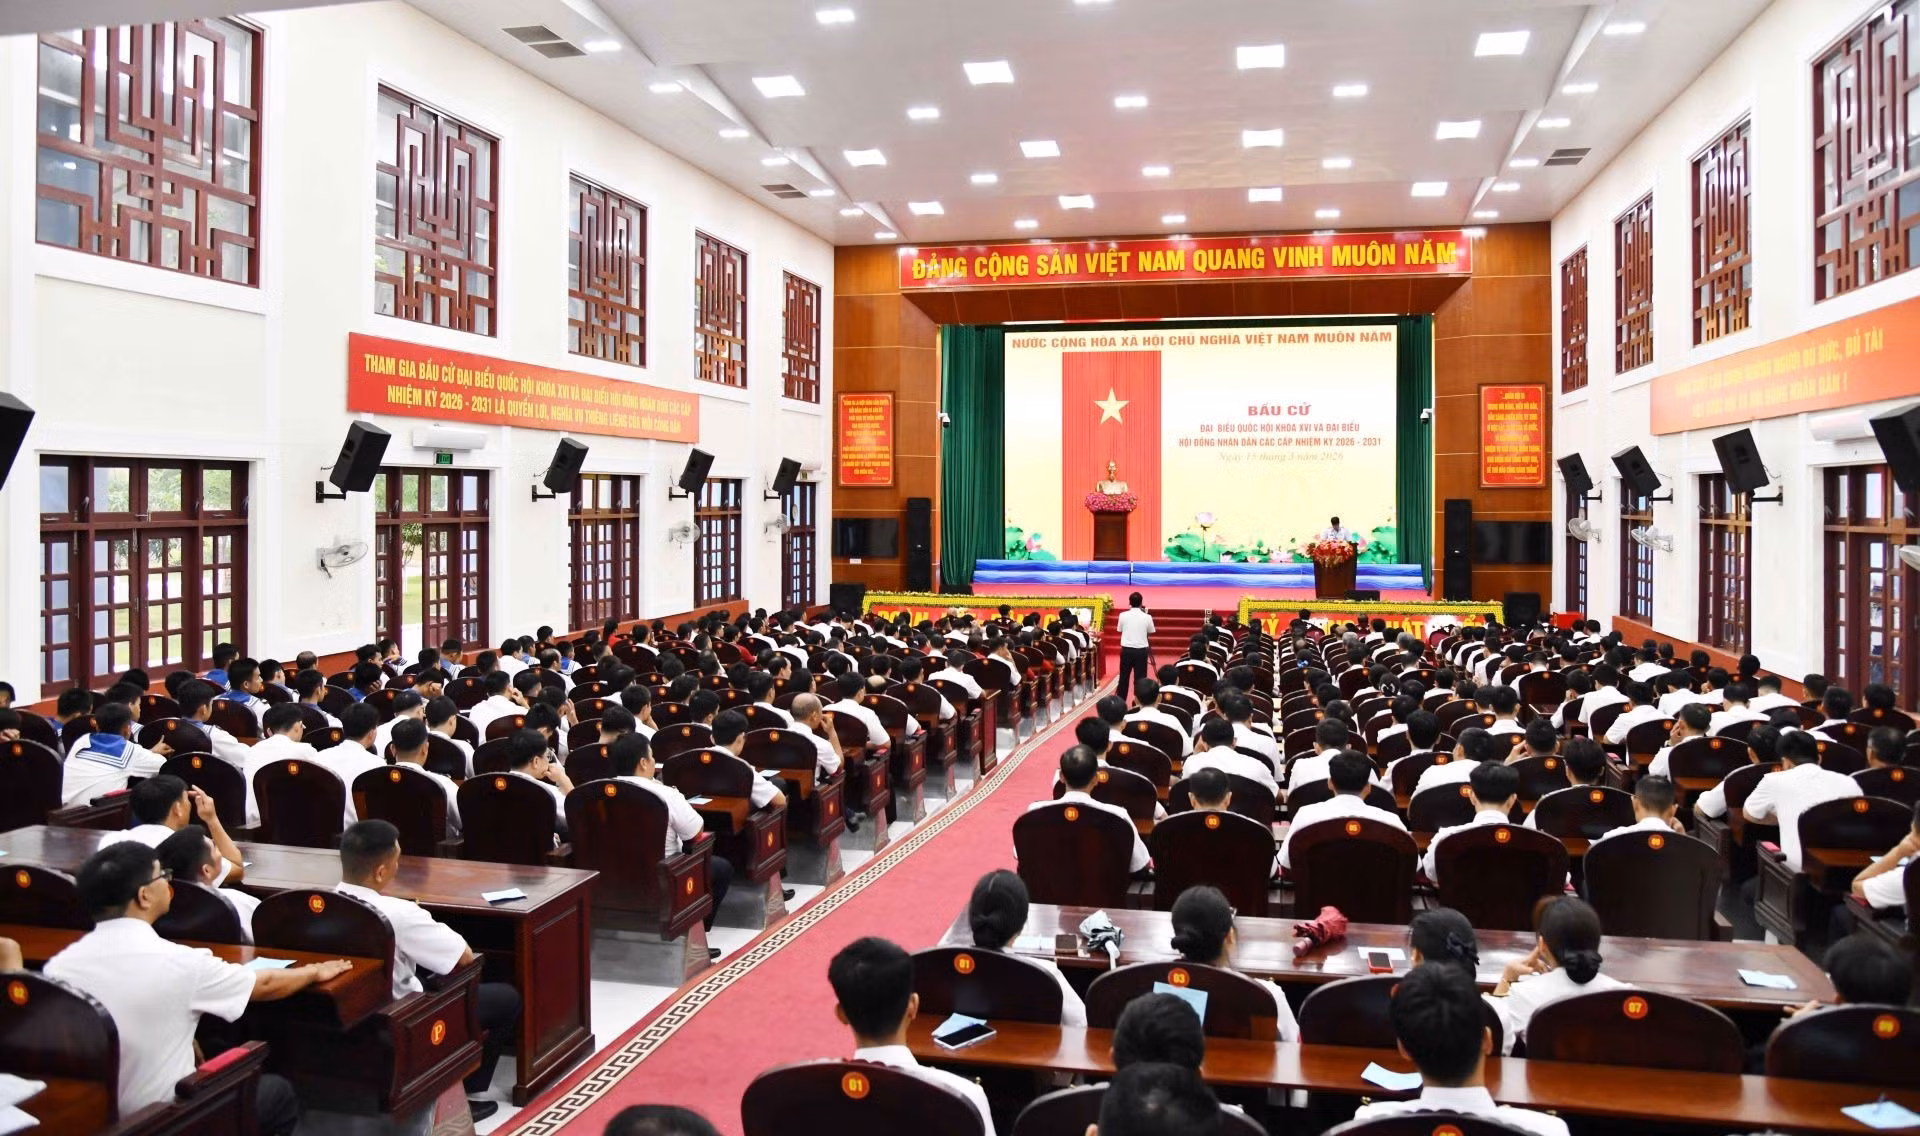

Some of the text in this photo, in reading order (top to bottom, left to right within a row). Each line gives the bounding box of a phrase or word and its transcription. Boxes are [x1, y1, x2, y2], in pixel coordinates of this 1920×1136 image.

[911, 238, 1457, 282] ĐẢNG CỘNG SẢN VIỆT NAM QUANG VINH MUÔN NĂM
[1012, 336, 1047, 348] NƯỚC
[1051, 335, 1086, 349] CỘNG
[1121, 334, 1138, 346] XÃ
[1142, 334, 1164, 348] HỘI
[1168, 333, 1195, 346] CHỦ
[1199, 332, 1241, 345] NGHĨA
[1245, 332, 1273, 346] VIỆT
[1277, 333, 1309, 344] NAM
[1313, 330, 1355, 343] MUÔN
[1359, 330, 1392, 343] NĂM
[1864, 325, 1884, 354] TÀI
[364, 353, 396, 376] THAM
[398, 358, 416, 379] GIA
[441, 361, 456, 384] CỬ
[456, 367, 473, 390] ĐẠI
[474, 365, 495, 389] BIỂU
[496, 371, 519, 394] QUỐC
[520, 374, 533, 398] HỘI
[535, 377, 556, 398] KHÓA
[557, 383, 570, 399] XVI
[570, 384, 580, 401] VÀ
[387, 384, 422, 408] NHIỆM
[424, 386, 437, 408] KỲ
[439, 391, 463, 411] 2026
[471, 395, 492, 413] 2031
[494, 396, 507, 415] LÀ
[507, 396, 534, 419] QUYỀN
[1299, 423, 1312, 432] XVI
[1336, 437, 1355, 446] 2026
[1363, 437, 1382, 446] 2031
[607, 786, 615, 794] 02
[1498, 831, 1507, 840] 07
[312, 898, 323, 908] 02
[959, 958, 970, 969] 01
[1173, 973, 1185, 984] 03
[1628, 1002, 1643, 1013] 07
[434, 1024, 443, 1042] P
[848, 1078, 863, 1092] 01
